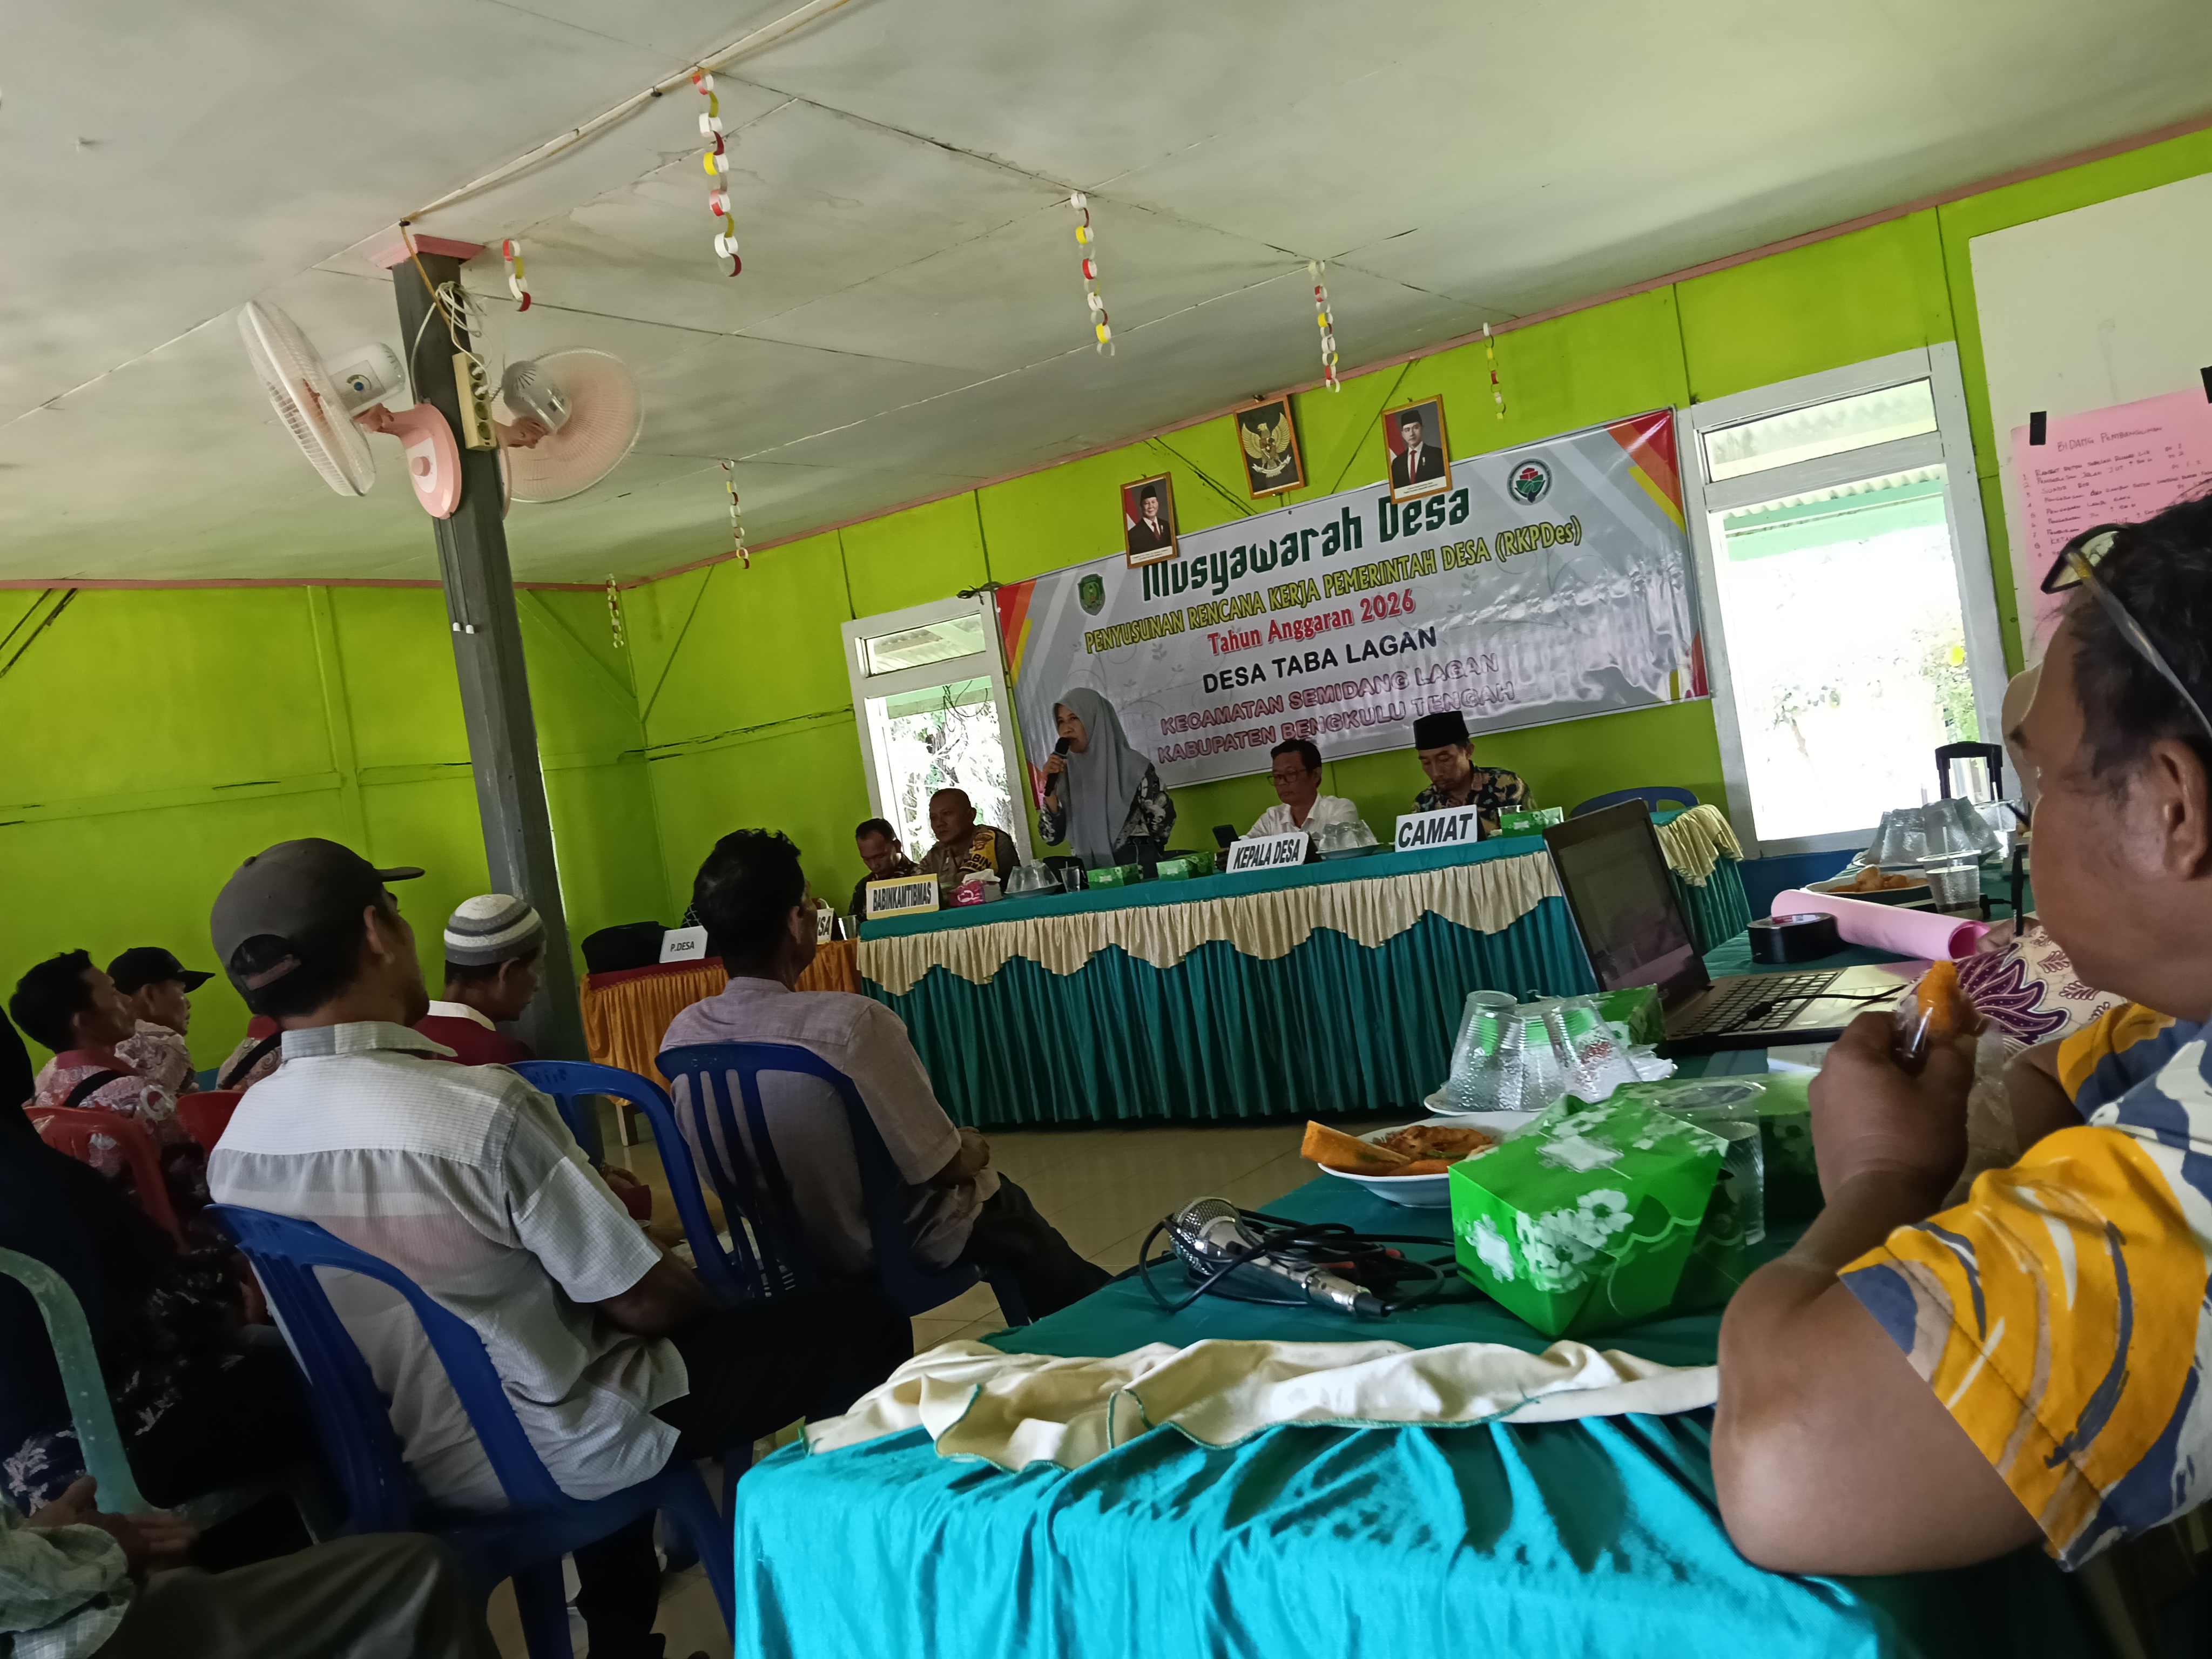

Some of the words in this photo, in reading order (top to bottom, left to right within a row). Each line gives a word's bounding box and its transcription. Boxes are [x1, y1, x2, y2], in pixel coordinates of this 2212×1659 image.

[2057, 436, 2094, 452] BIDANG
[1142, 506, 1363, 602] Musyawarah
[1378, 487, 1470, 543] Desa
[1084, 610, 1185, 654] PENYUSUNAN
[1188, 591, 1266, 630] RENCANA
[1267, 578, 1321, 611] KERJA
[1323, 549, 1438, 597] PEMERINTAH
[1440, 536, 1492, 571] DESA
[1495, 515, 1582, 563] (RKPDes)
[1207, 628, 1263, 656] Tahun
[1268, 605, 1354, 642] Anggaran
[1359, 588, 1417, 623] 2026
[1203, 663, 1266, 693] DESA
[1271, 648, 1338, 678] TABA
[1345, 626, 1438, 664] LAGAN
[1160, 694, 1285, 736] KECAMATAN
[1288, 671, 1410, 710] SEMIDANG
[1414, 652, 1500, 686] LAGAN
[1157, 725, 1277, 764] KABUPATEN
[1280, 701, 1407, 741] BENGKULU
[1411, 681, 1516, 717] TENGAH
[1233, 843, 1272, 870] KEPALA
[1273, 839, 1300, 865] DESA
[1398, 813, 1474, 848] CAMAT
[969, 853, 992, 869] BIN
[873, 881, 932, 912] BABINKAMTIBMAS
[670, 941, 694, 952] P.DESA
